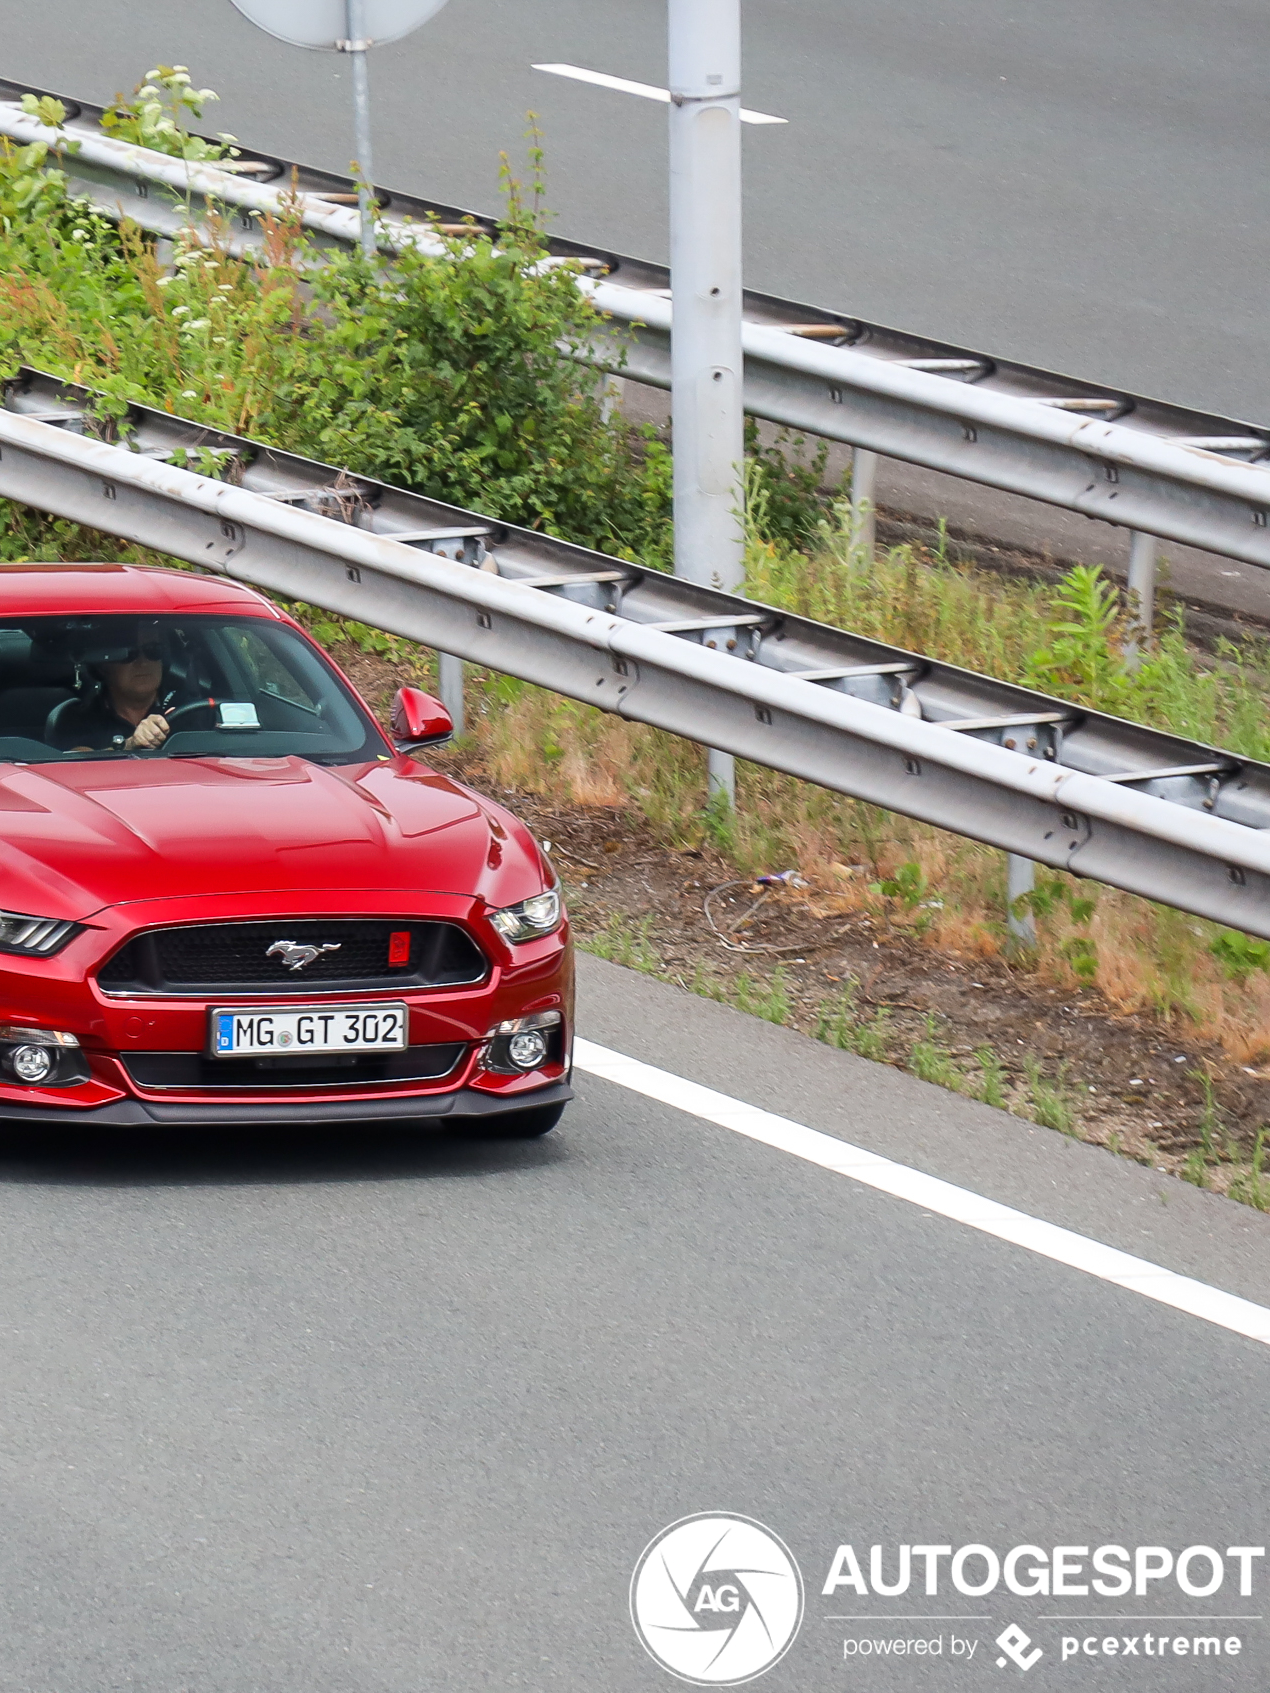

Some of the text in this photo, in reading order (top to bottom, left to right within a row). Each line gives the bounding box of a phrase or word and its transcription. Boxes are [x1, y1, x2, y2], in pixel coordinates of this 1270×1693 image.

[236, 1013, 398, 1047] MG GT 302
